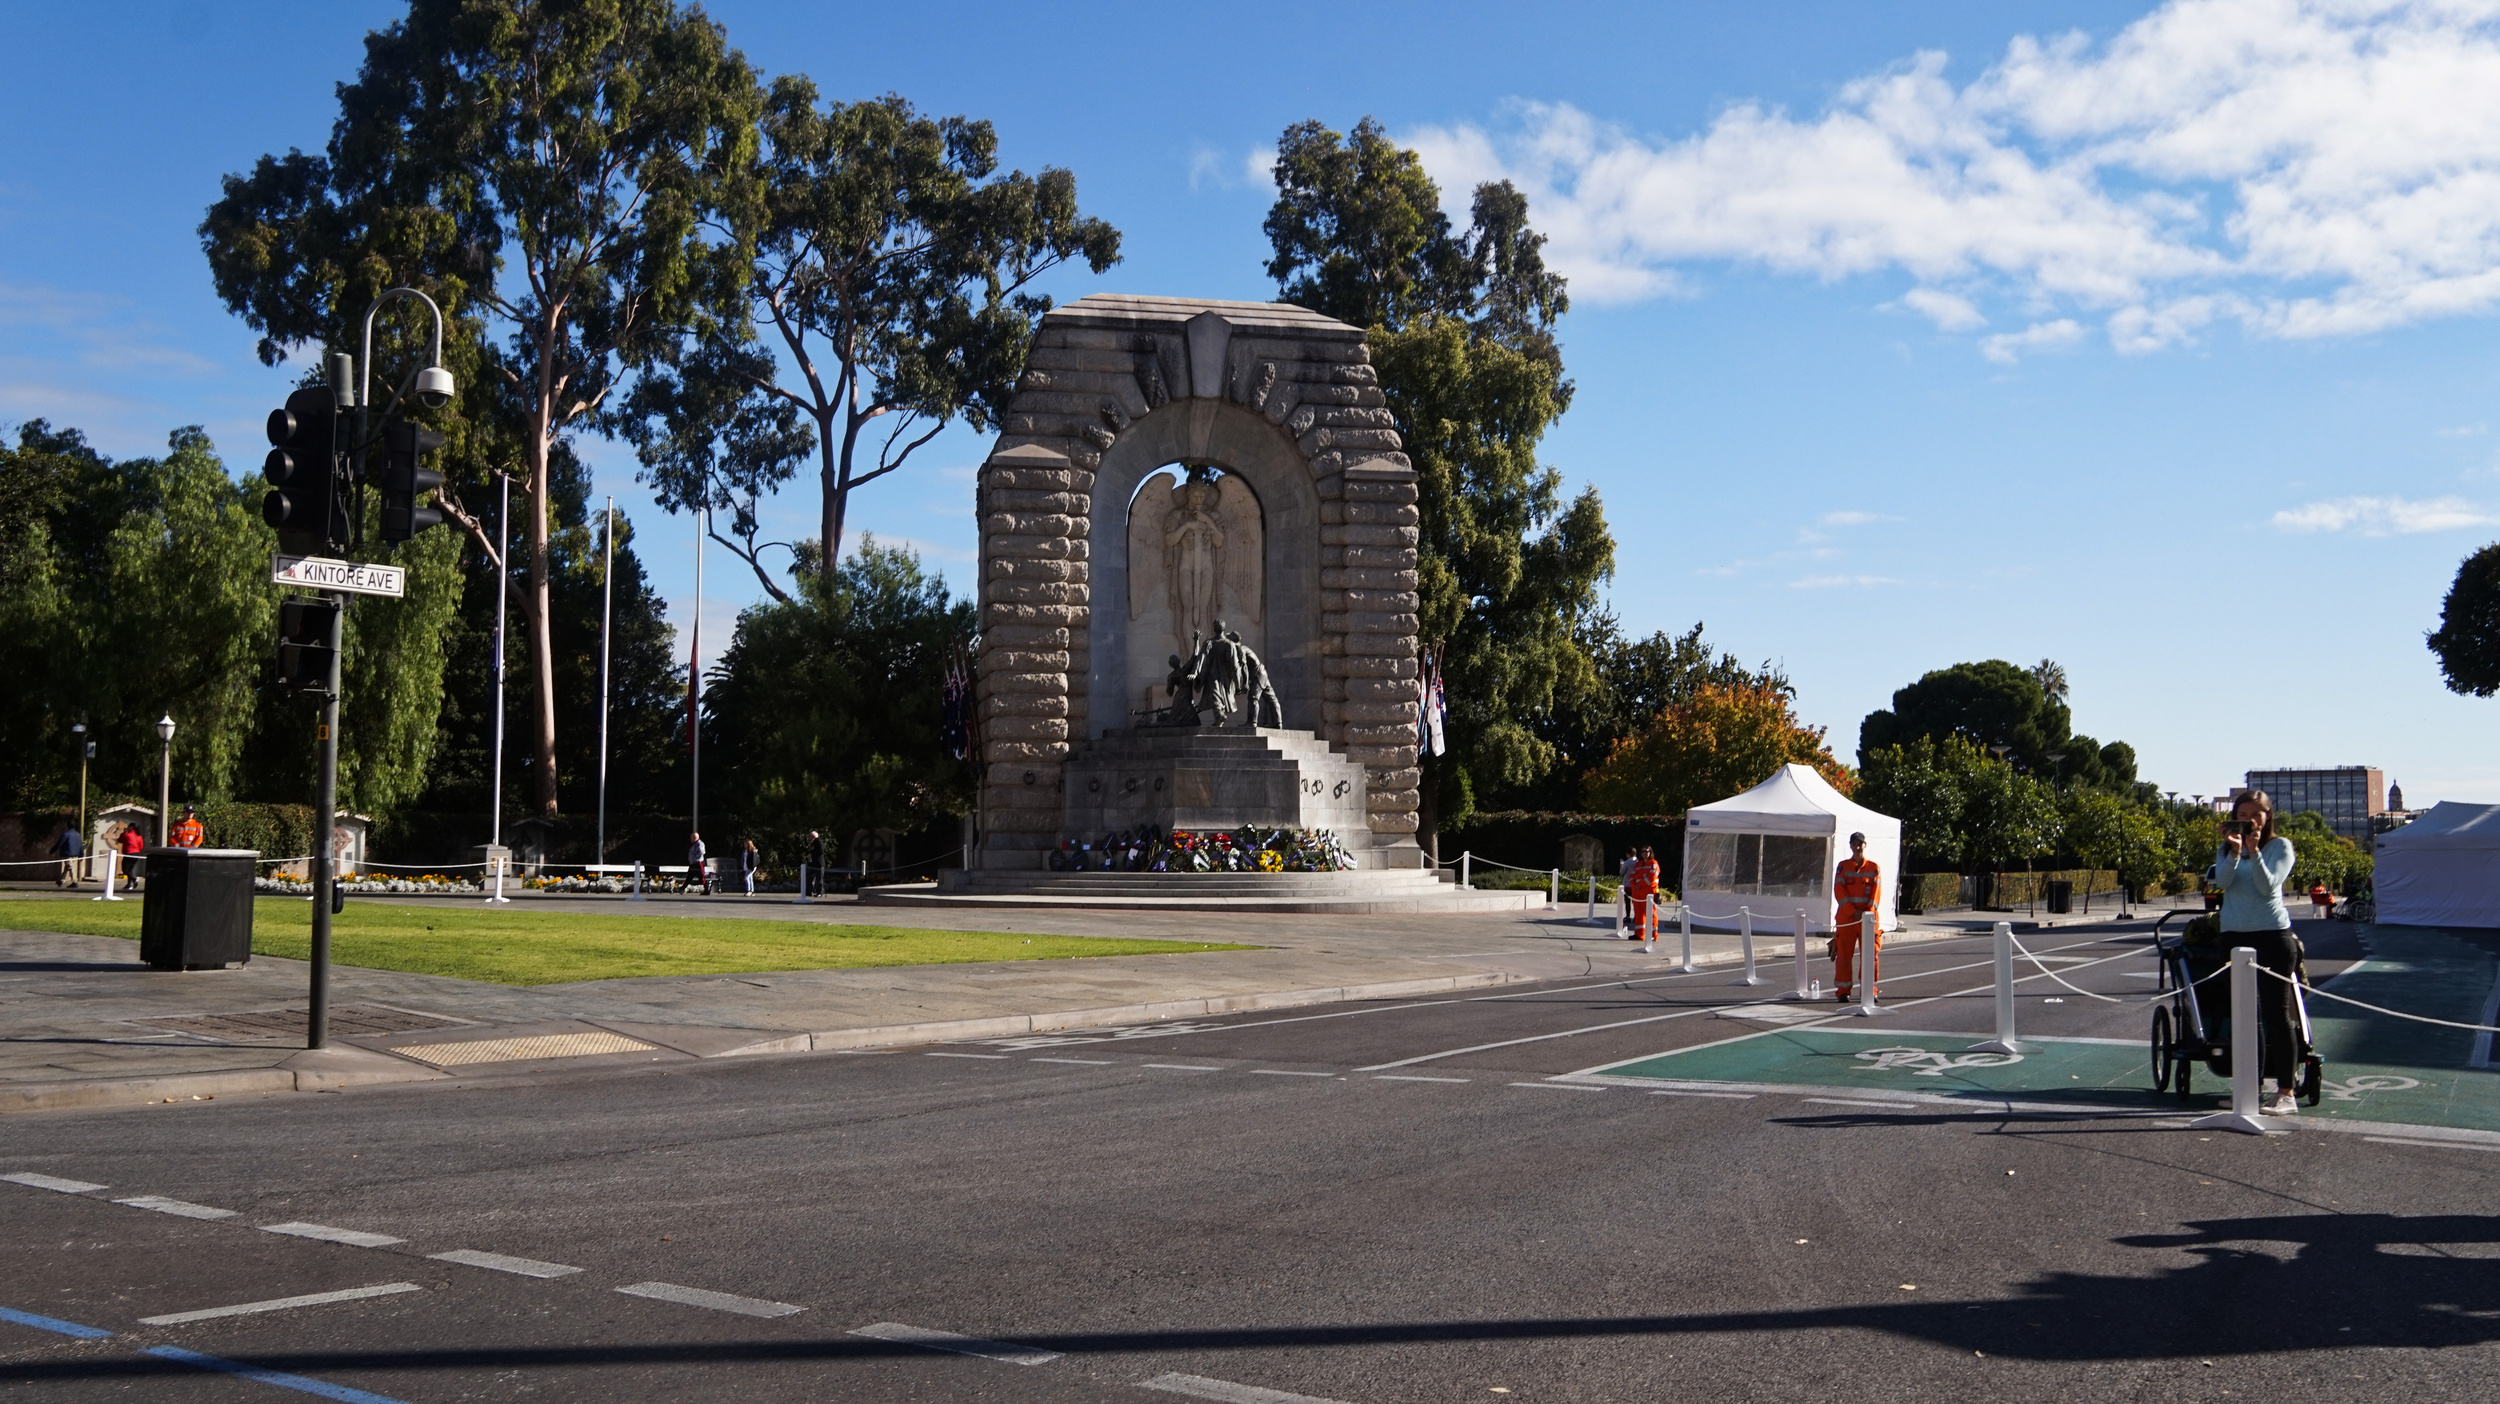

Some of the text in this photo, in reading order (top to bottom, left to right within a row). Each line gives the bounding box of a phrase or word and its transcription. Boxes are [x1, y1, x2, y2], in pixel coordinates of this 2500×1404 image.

[304, 564, 393, 589] KINTORE AVE
[320, 726, 326, 738] 6
